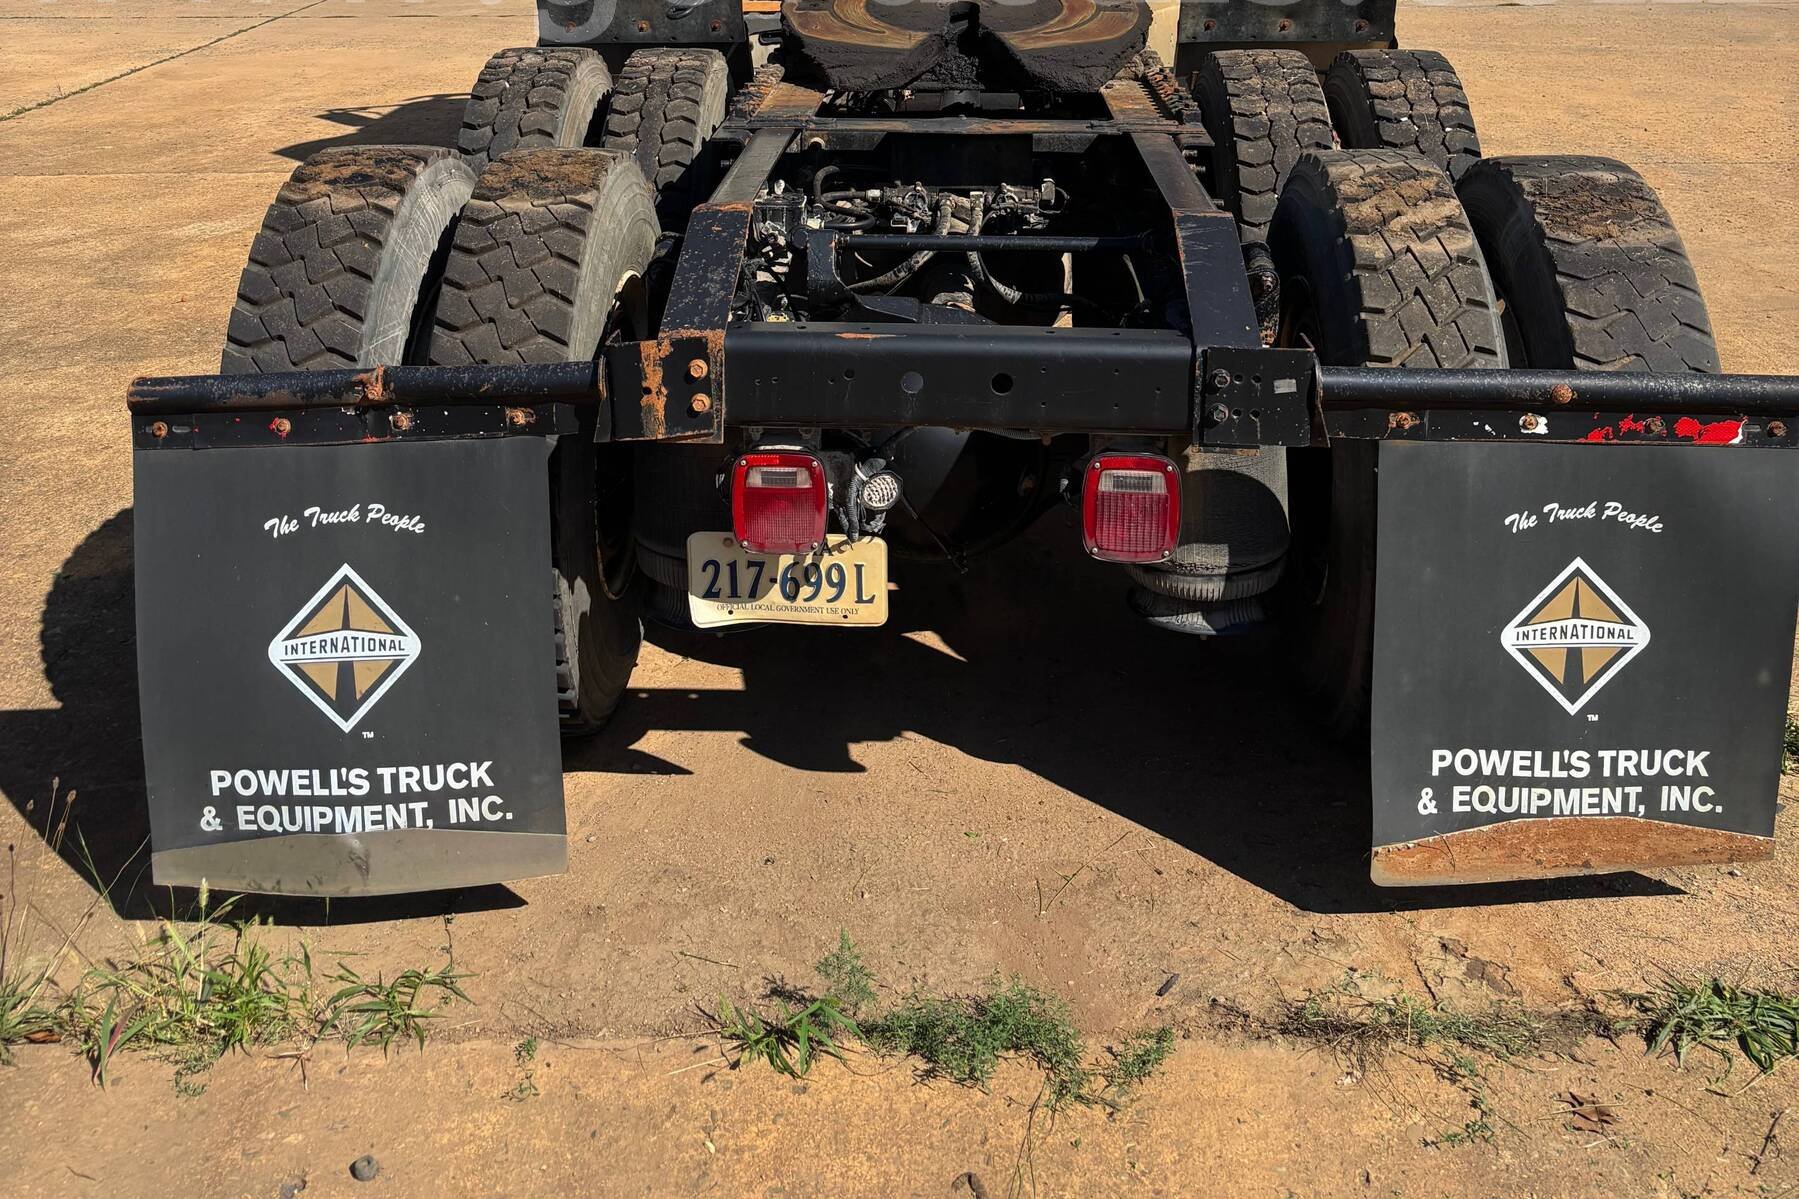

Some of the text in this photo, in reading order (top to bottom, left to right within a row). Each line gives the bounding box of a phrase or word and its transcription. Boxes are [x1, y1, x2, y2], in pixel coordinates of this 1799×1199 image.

[263, 503, 426, 538] The Truck People
[1504, 500, 1664, 533] The Truck People
[716, 603, 860, 616] OFFICIAL LOCAL GOVERNMENT USE ONLY
[284, 636, 406, 656] INTERNATIONAL
[1516, 624, 1634, 641] INTERNATIONAL
[210, 760, 495, 797] POWELL'S TRUCK
[1431, 749, 1711, 778] POWELL'S TRUCK
[200, 795, 513, 833] & EQUIPMENT, INC.
[1417, 785, 1723, 817] & EQUIPMENT, INC.
